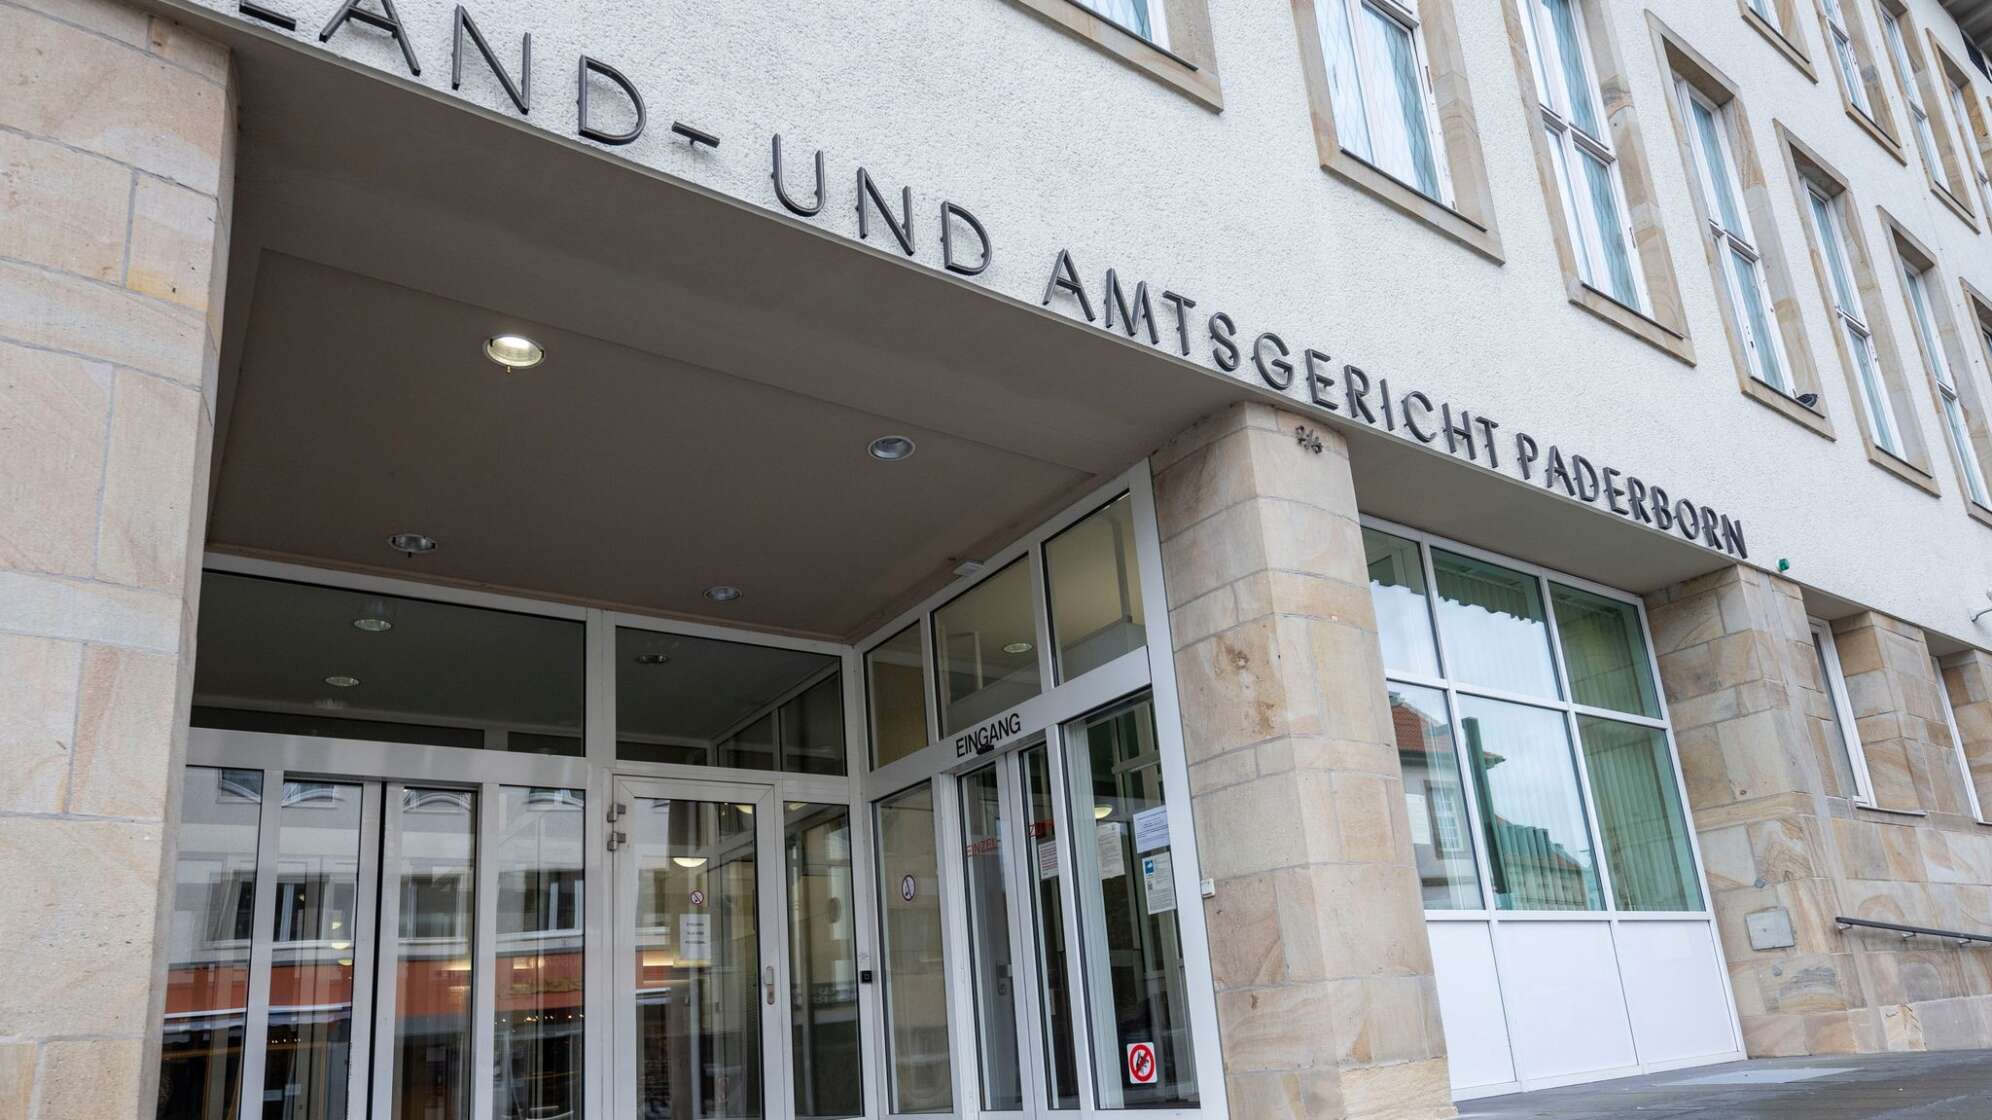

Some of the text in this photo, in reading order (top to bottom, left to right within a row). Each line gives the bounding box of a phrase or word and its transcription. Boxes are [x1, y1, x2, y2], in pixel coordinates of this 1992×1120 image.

[239, 0, 1749, 560] AND- UND AMTSGERICHT PADERBORN
[956, 713, 1021, 758] EINGANG
